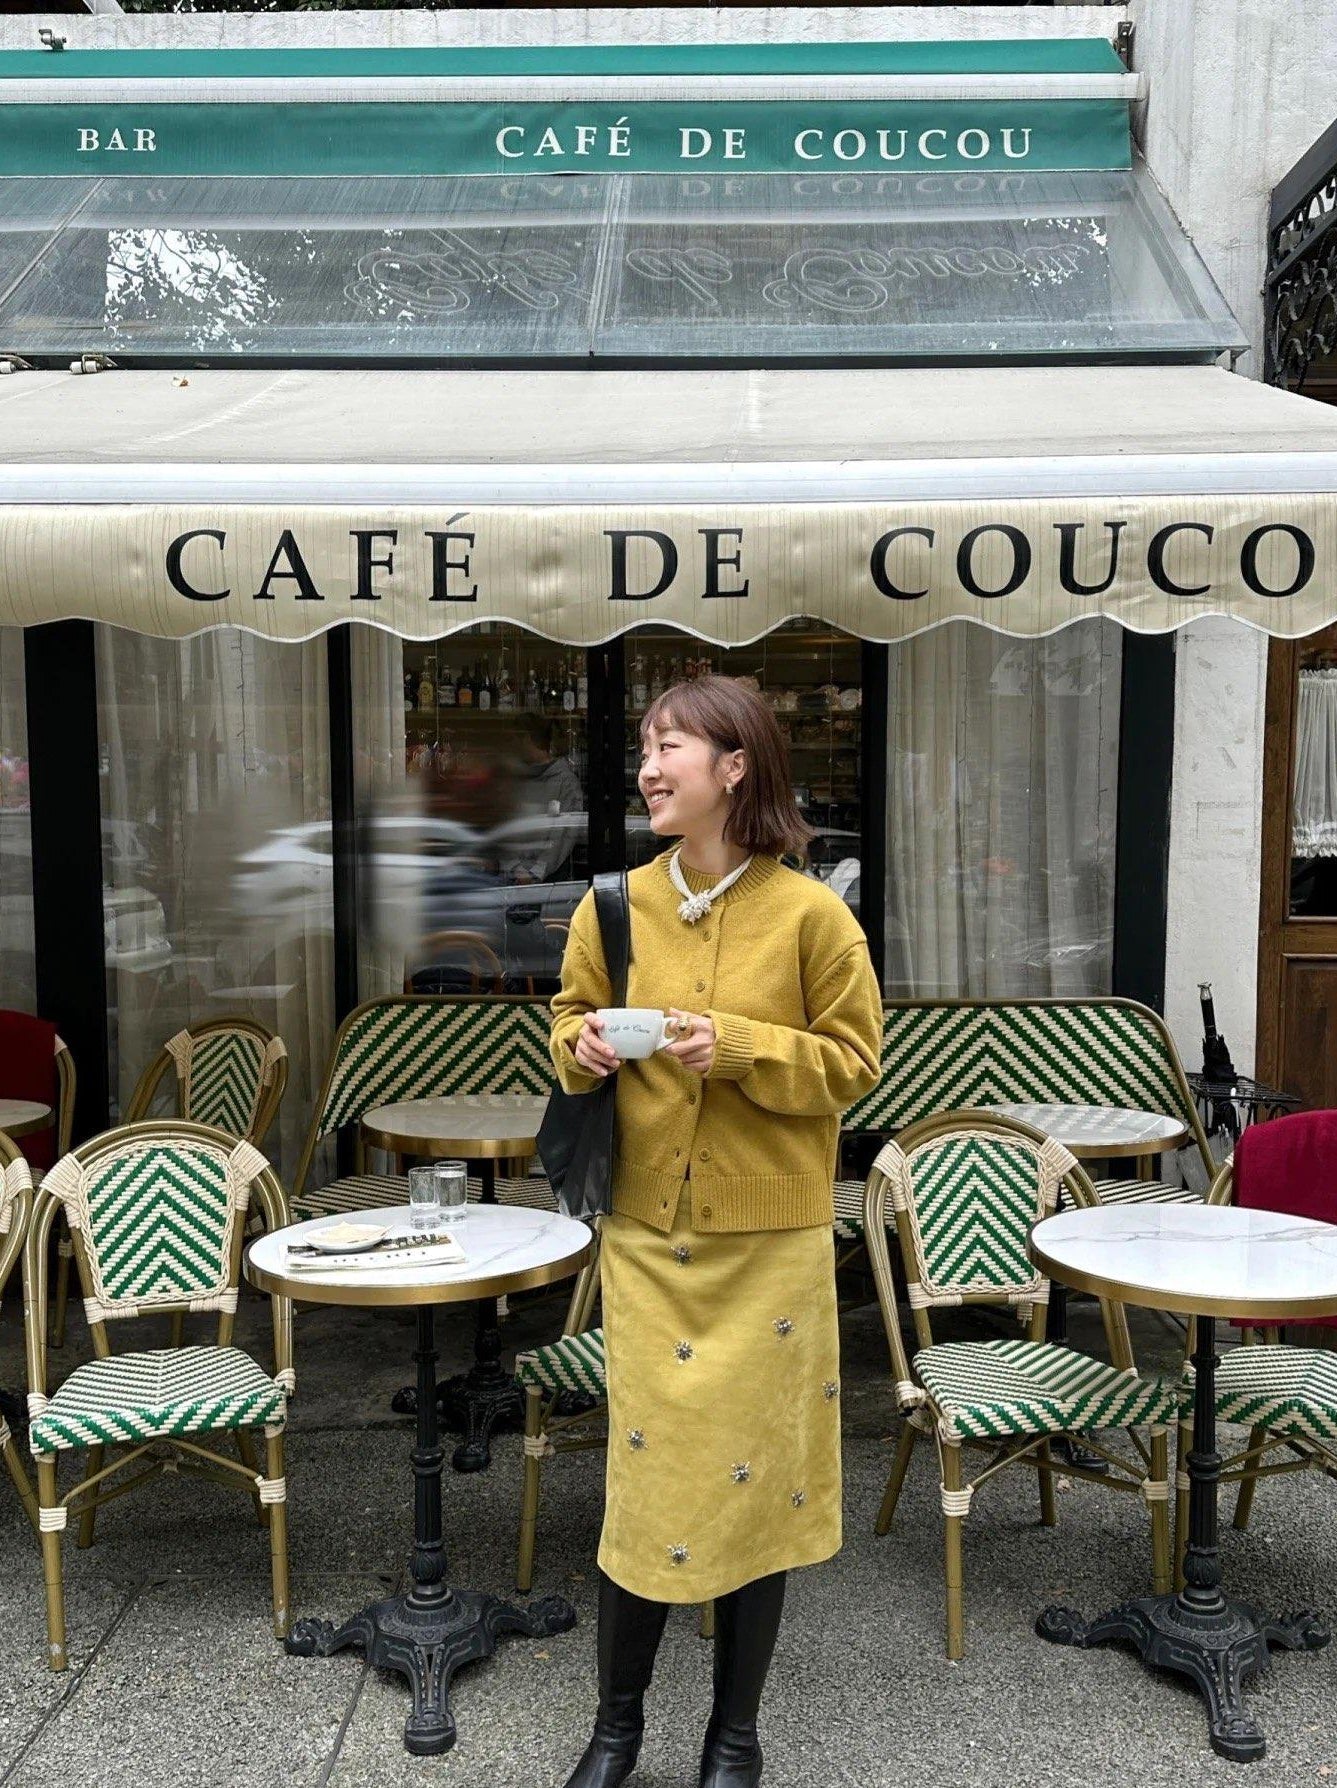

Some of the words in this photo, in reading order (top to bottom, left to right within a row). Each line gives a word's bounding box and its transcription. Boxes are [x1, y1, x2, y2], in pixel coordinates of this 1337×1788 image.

[76, 128, 157, 152] BAR
[495, 117, 632, 158] CAFÉ
[679, 128, 746, 159] DE
[794, 128, 1033, 161] COUCOU
[165, 512, 478, 602] CAFÉ
[603, 528, 750, 601] DE
[870, 520, 1315, 601] COUCO
